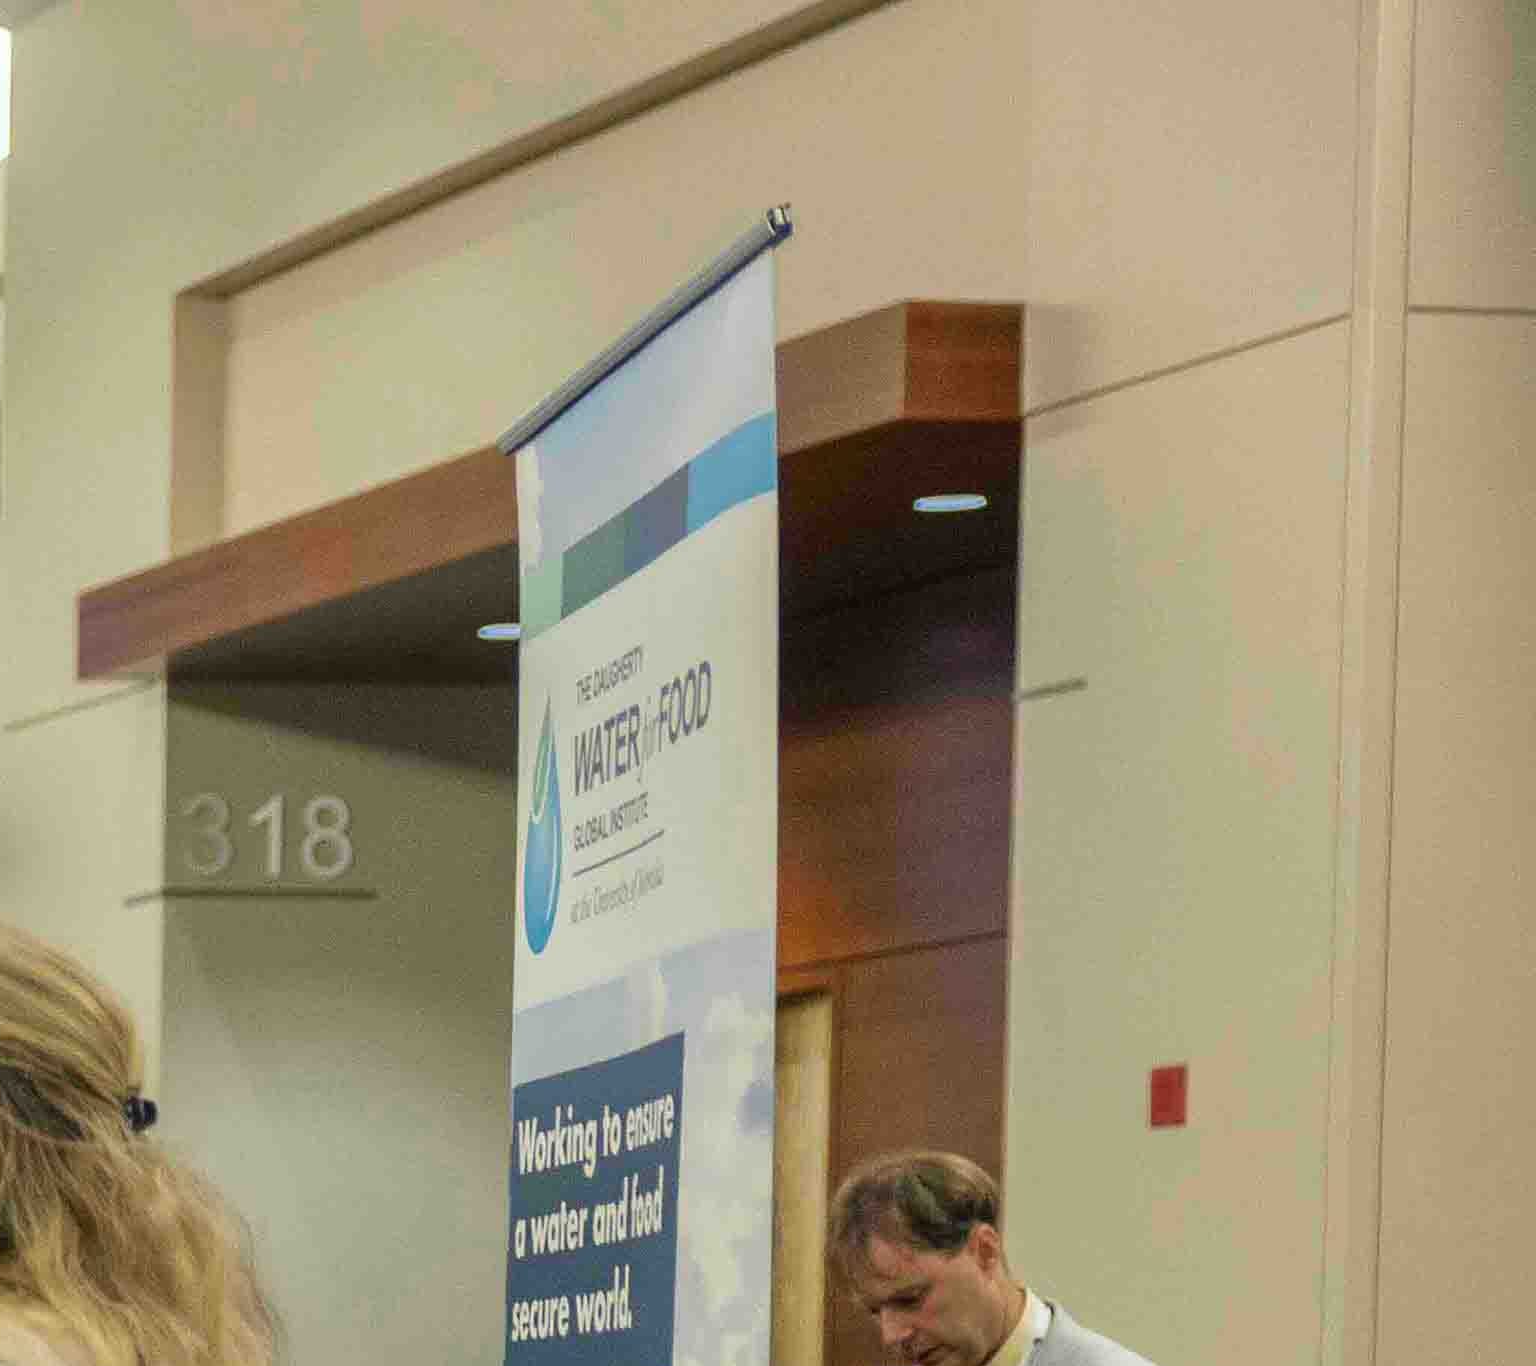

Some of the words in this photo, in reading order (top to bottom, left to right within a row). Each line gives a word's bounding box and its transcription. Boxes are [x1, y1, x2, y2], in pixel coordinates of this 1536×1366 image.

[574, 704, 640, 796] WATER
[658, 661, 712, 745] FOOD
[184, 793, 355, 880] 318
[518, 1105, 598, 1179] Working
[602, 1105, 621, 1158] to
[626, 1093, 674, 1149] ensure
[515, 1219, 525, 1259] a
[531, 1200, 587, 1254] water
[592, 1178, 627, 1245] and
[630, 1165, 664, 1239] food
[511, 1295, 569, 1342] secure
[576, 1265, 632, 1334] world.
